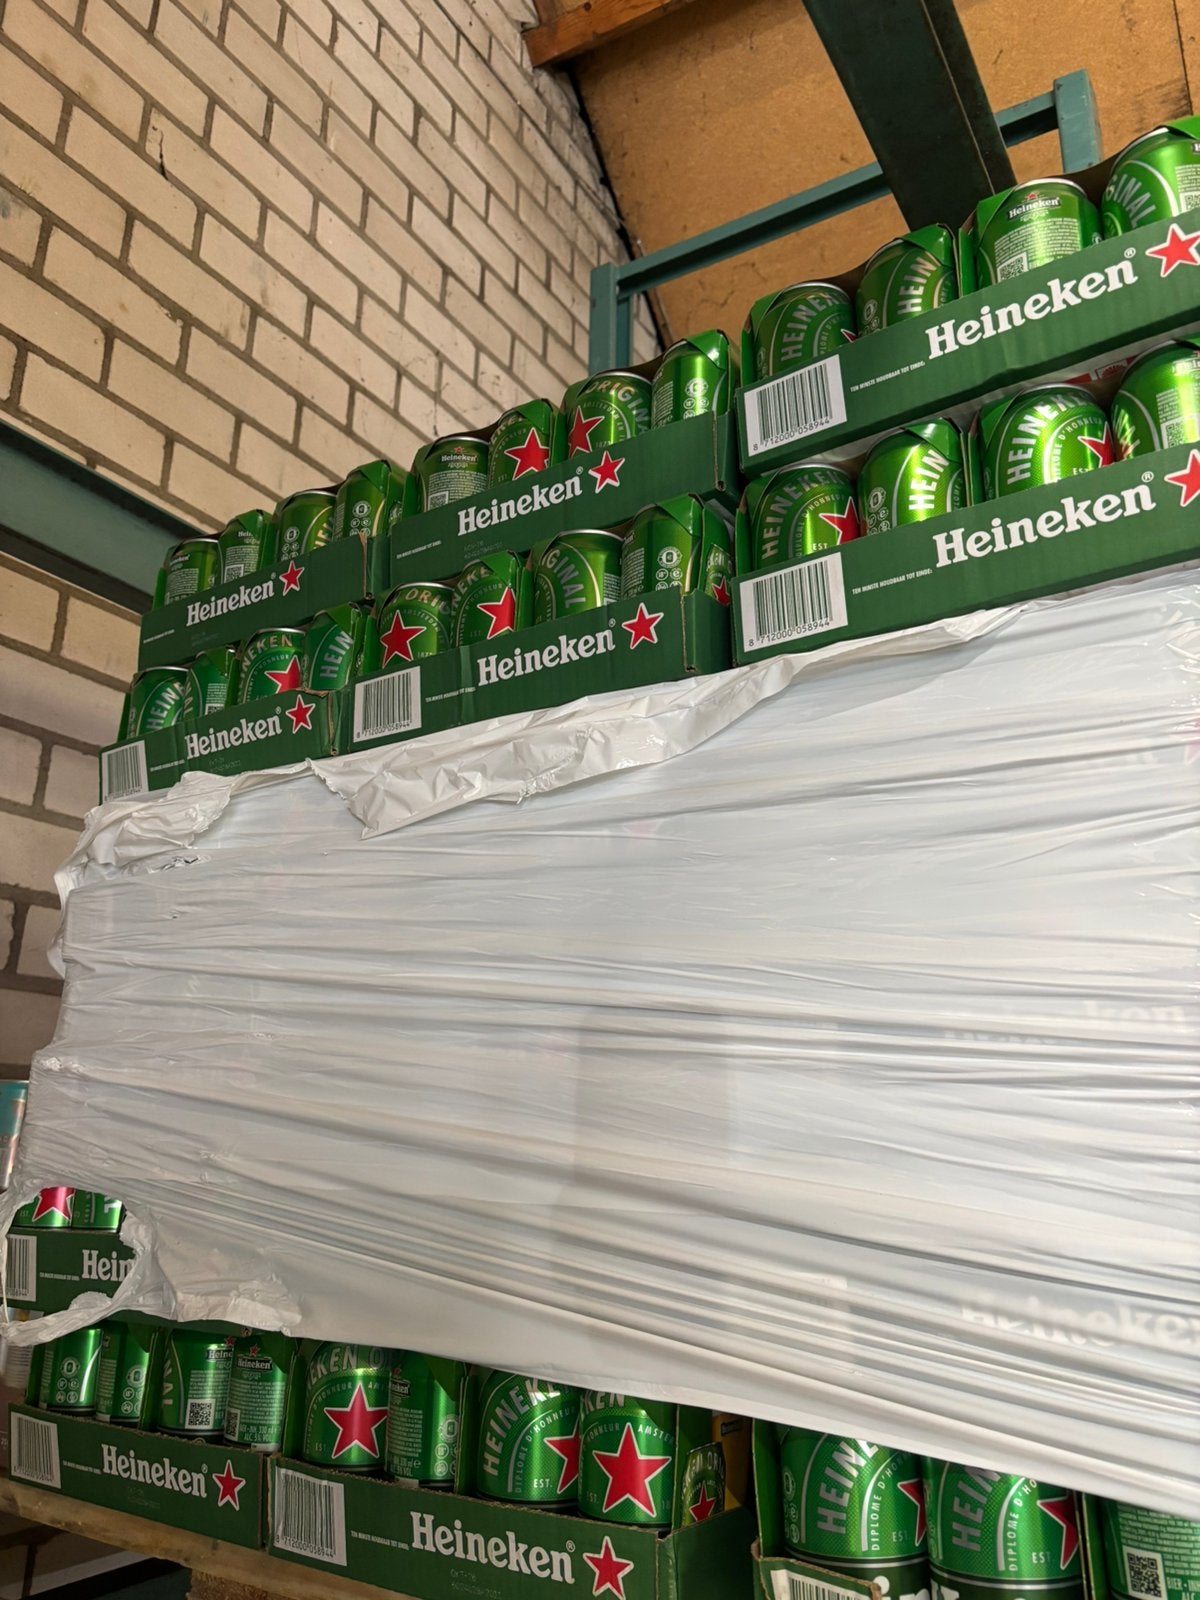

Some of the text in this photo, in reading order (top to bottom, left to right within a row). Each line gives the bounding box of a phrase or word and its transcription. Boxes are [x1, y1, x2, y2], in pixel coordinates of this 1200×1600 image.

[1009, 199, 1060, 219] Heineken
[925, 258, 1139, 361] Heineken
[752, 418, 830, 451] 8 712000 058944
[457, 473, 583, 537] Heineken
[908, 449, 950, 511] HEIN
[932, 482, 1157, 568] Heineken
[186, 579, 275, 627] Heineken
[320, 631, 355, 679] HEIN
[477, 628, 616, 687] Heineken
[748, 621, 830, 647] 8 712000 058944
[184, 714, 283, 760] Heineken
[101, 1443, 208, 1498] Heineken
[533, 1478, 552, 1488] EST.
[409, 1511, 576, 1584] Heineken
[870, 1494, 882, 1551] DIPLOME
[1007, 1512, 1019, 1572] DIPLOME
